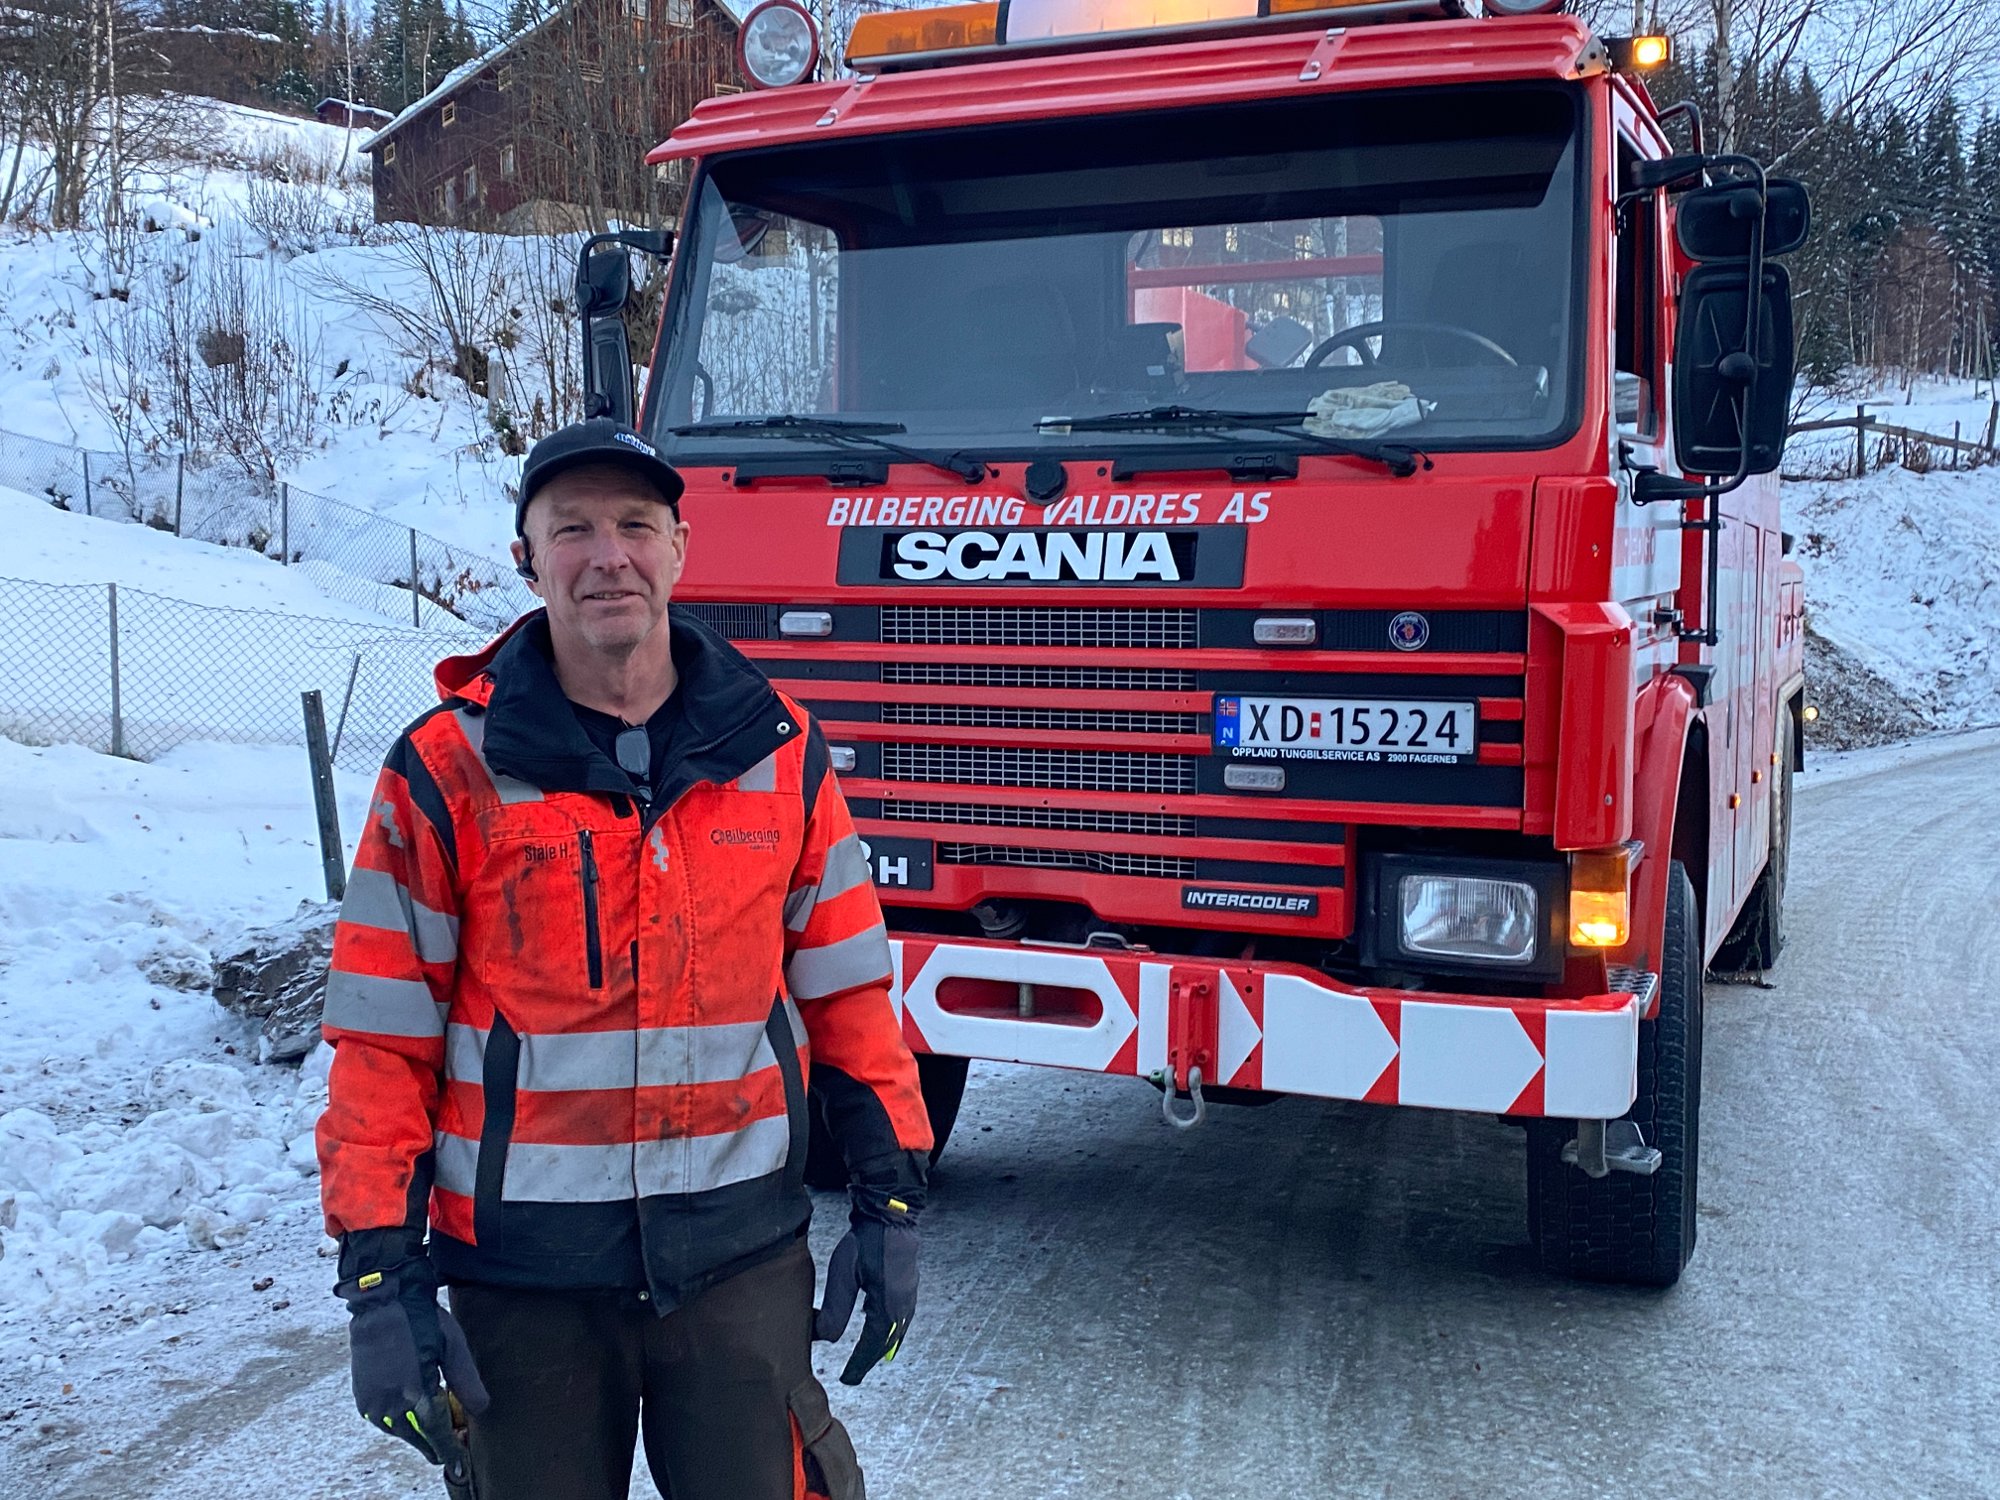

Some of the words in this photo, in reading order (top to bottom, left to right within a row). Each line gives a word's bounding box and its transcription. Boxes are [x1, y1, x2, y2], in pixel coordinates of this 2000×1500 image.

[827, 497, 1026, 526] BILBERGING
[1043, 494, 1200, 524] VALDRES
[1217, 492, 1271, 523] AS
[894, 531, 1180, 581] SCANIA
[1222, 727, 1234, 739] N
[1330, 706, 1460, 748] 15224
[1232, 747, 1277, 759] OPPLAND
[1280, 749, 1364, 762] TUNGBILSERVICE
[1366, 752, 1381, 762] AS
[1388, 753, 1407, 763] 2900
[1410, 754, 1457, 764] FAGERNES
[725, 828, 780, 843] Bilberging
[1187, 892, 1310, 911] INTERCOOLER
